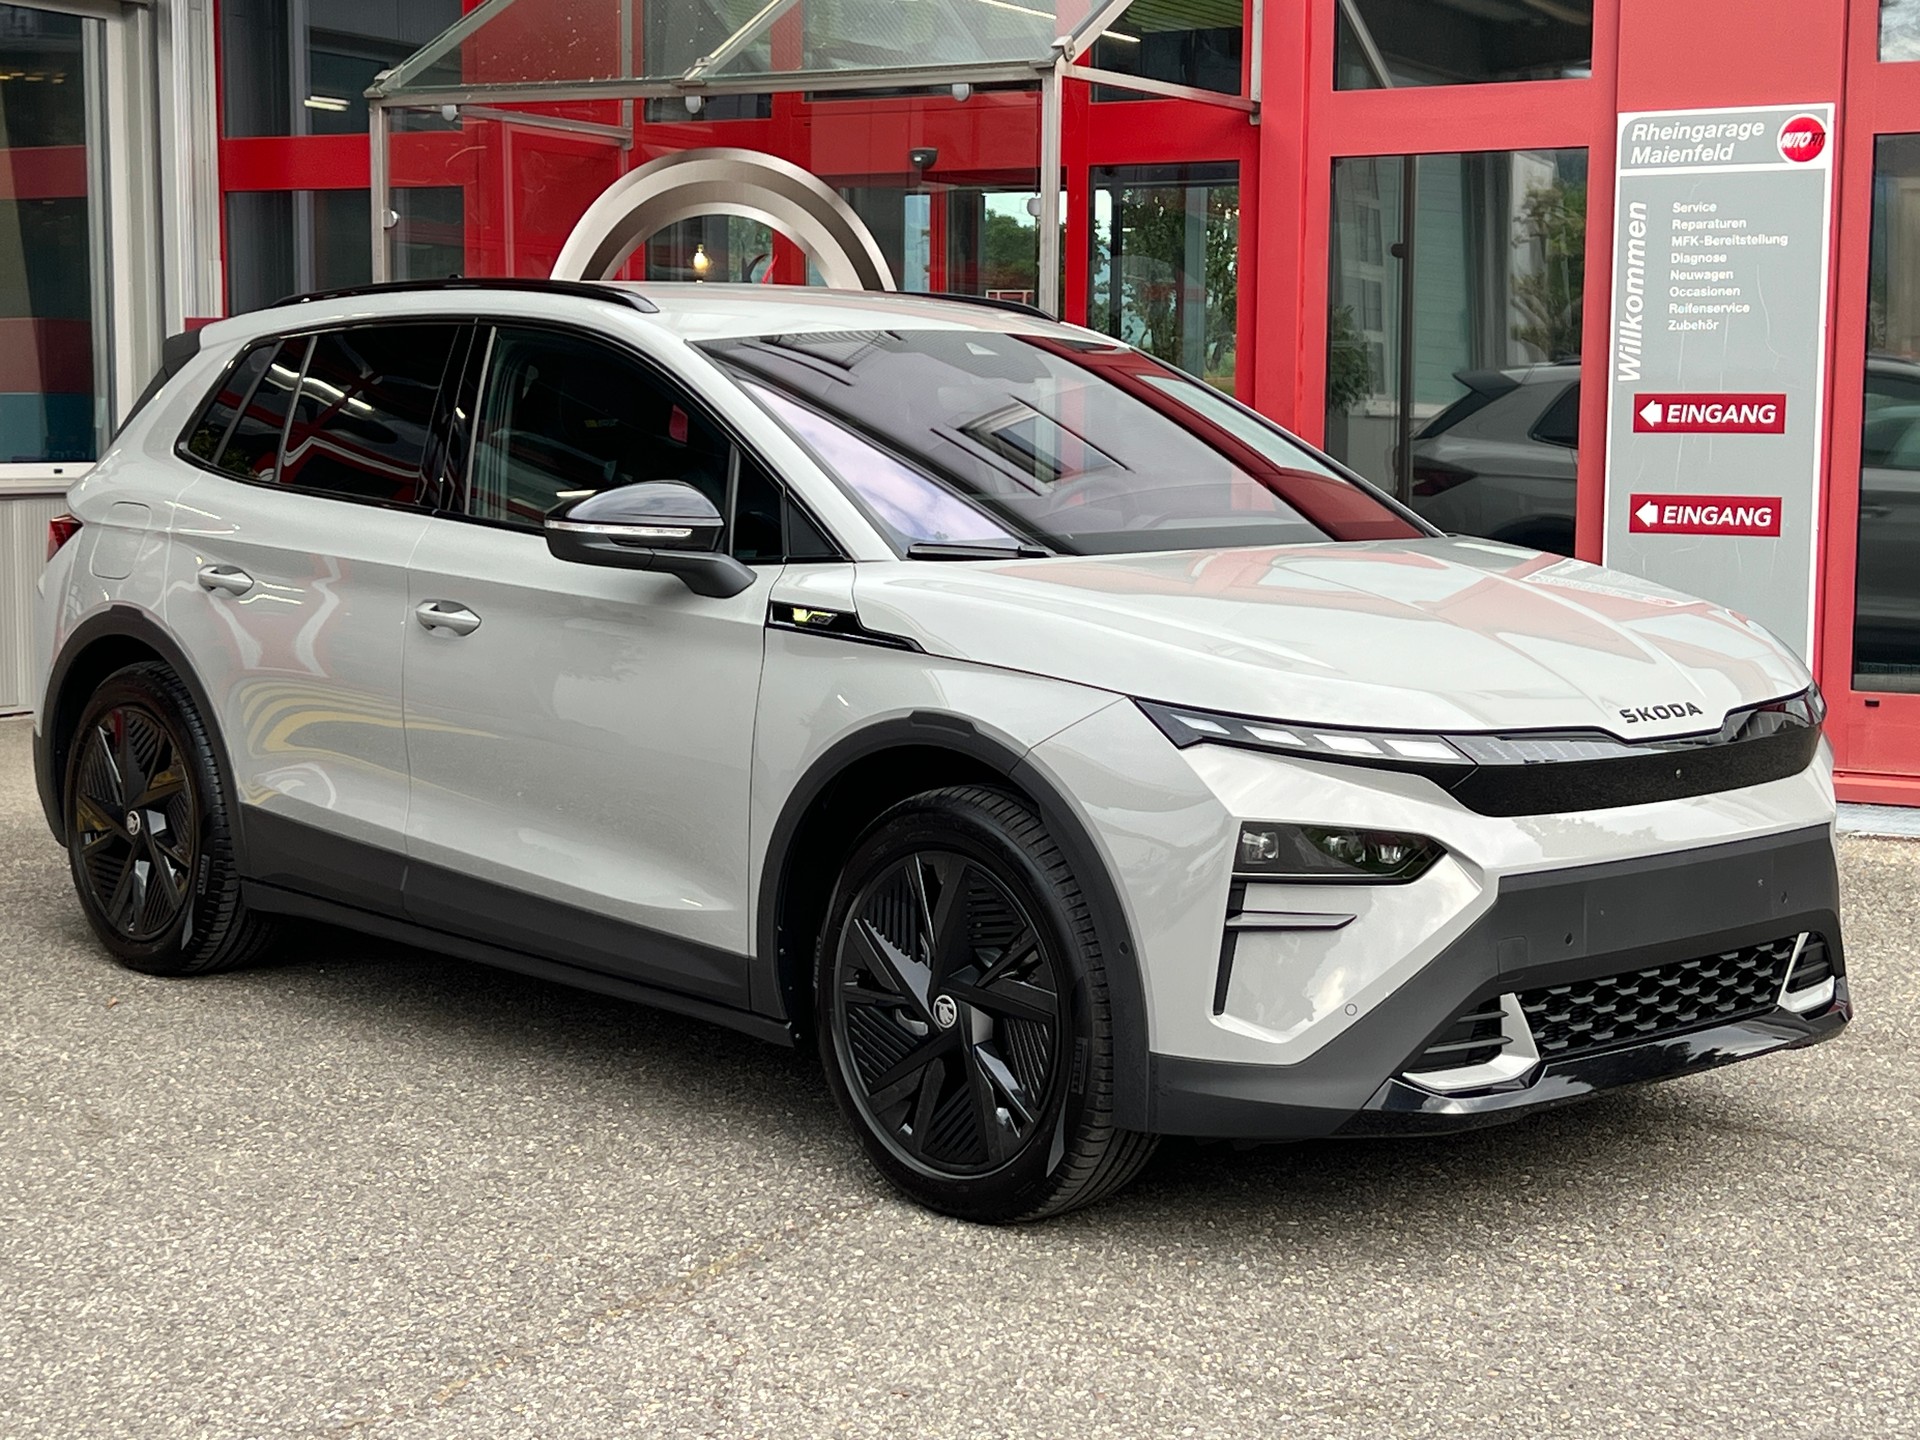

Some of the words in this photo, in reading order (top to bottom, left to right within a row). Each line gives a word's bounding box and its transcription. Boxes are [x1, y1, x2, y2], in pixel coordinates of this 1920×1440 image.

[1631, 120, 1765, 142] Rheingarage
[1630, 143, 1735, 165] Maienfeld
[1672, 201, 1717, 213] Service
[1672, 218, 1747, 231] Reparaturen
[1671, 233, 1788, 247] MFK-Bereitstellung
[1670, 252, 1727, 265] Diagnose
[1670, 269, 1734, 282] Neuwagen
[1617, 201, 1647, 382] Willkommen
[1669, 286, 1741, 297] Occasionen
[1668, 302, 1750, 314] Reifenservice
[1667, 318, 1719, 331] Zubehör
[1666, 403, 1777, 424] EINGANG
[1662, 505, 1773, 527] EINGANG
